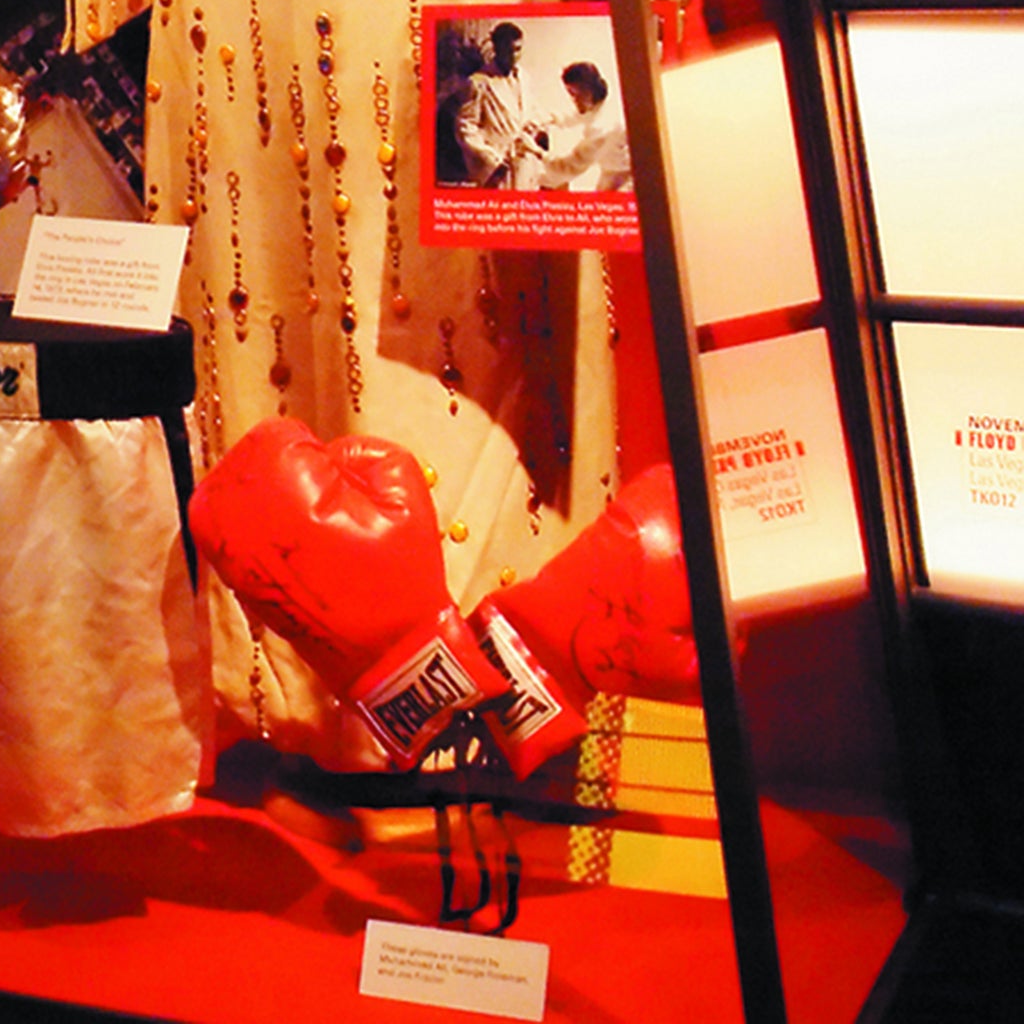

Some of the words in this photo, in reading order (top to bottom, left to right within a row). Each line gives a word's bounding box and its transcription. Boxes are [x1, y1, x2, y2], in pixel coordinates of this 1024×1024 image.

[969, 431, 1016, 451] FLOYD
[970, 488, 1017, 508] TKO12
[373, 653, 467, 747] EVERLAST
